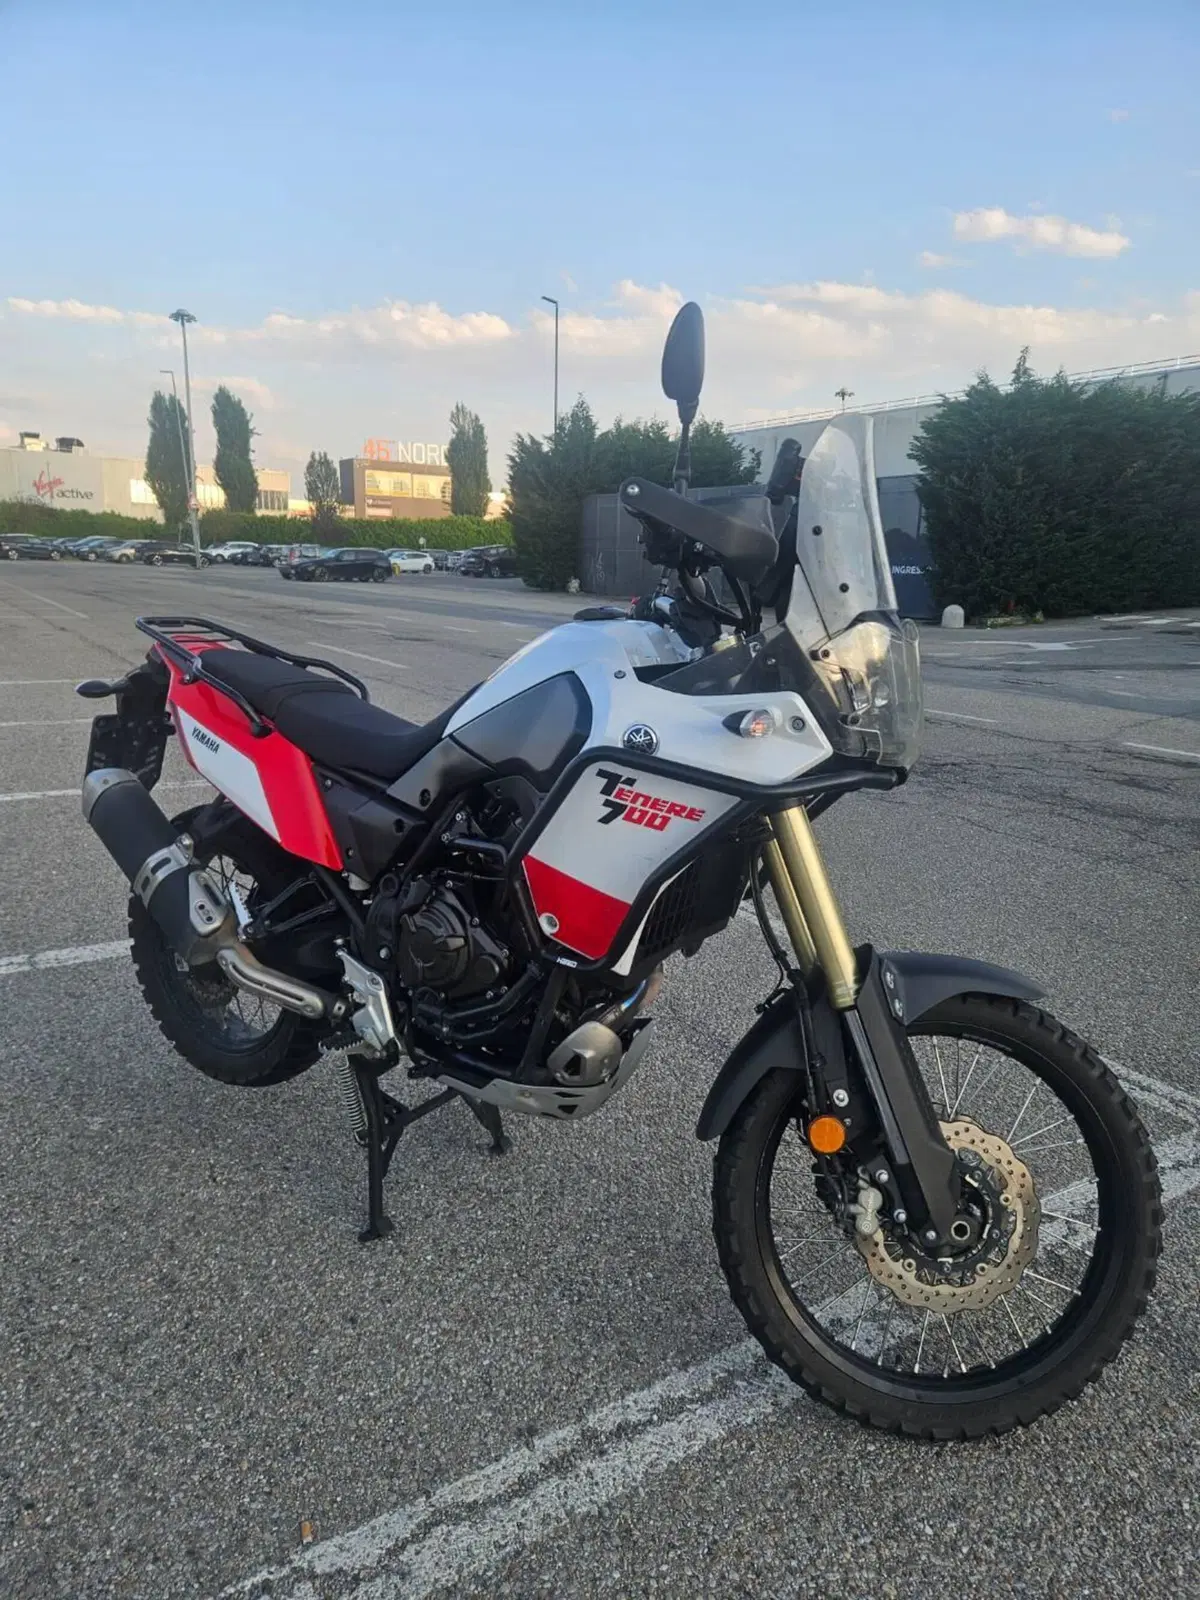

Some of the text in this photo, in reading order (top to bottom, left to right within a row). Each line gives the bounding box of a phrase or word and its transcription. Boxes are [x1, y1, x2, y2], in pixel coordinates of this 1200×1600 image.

[56, 488, 94, 500] active
[192, 726, 220, 754] YAMAHA
[597, 798, 672, 832] 700
